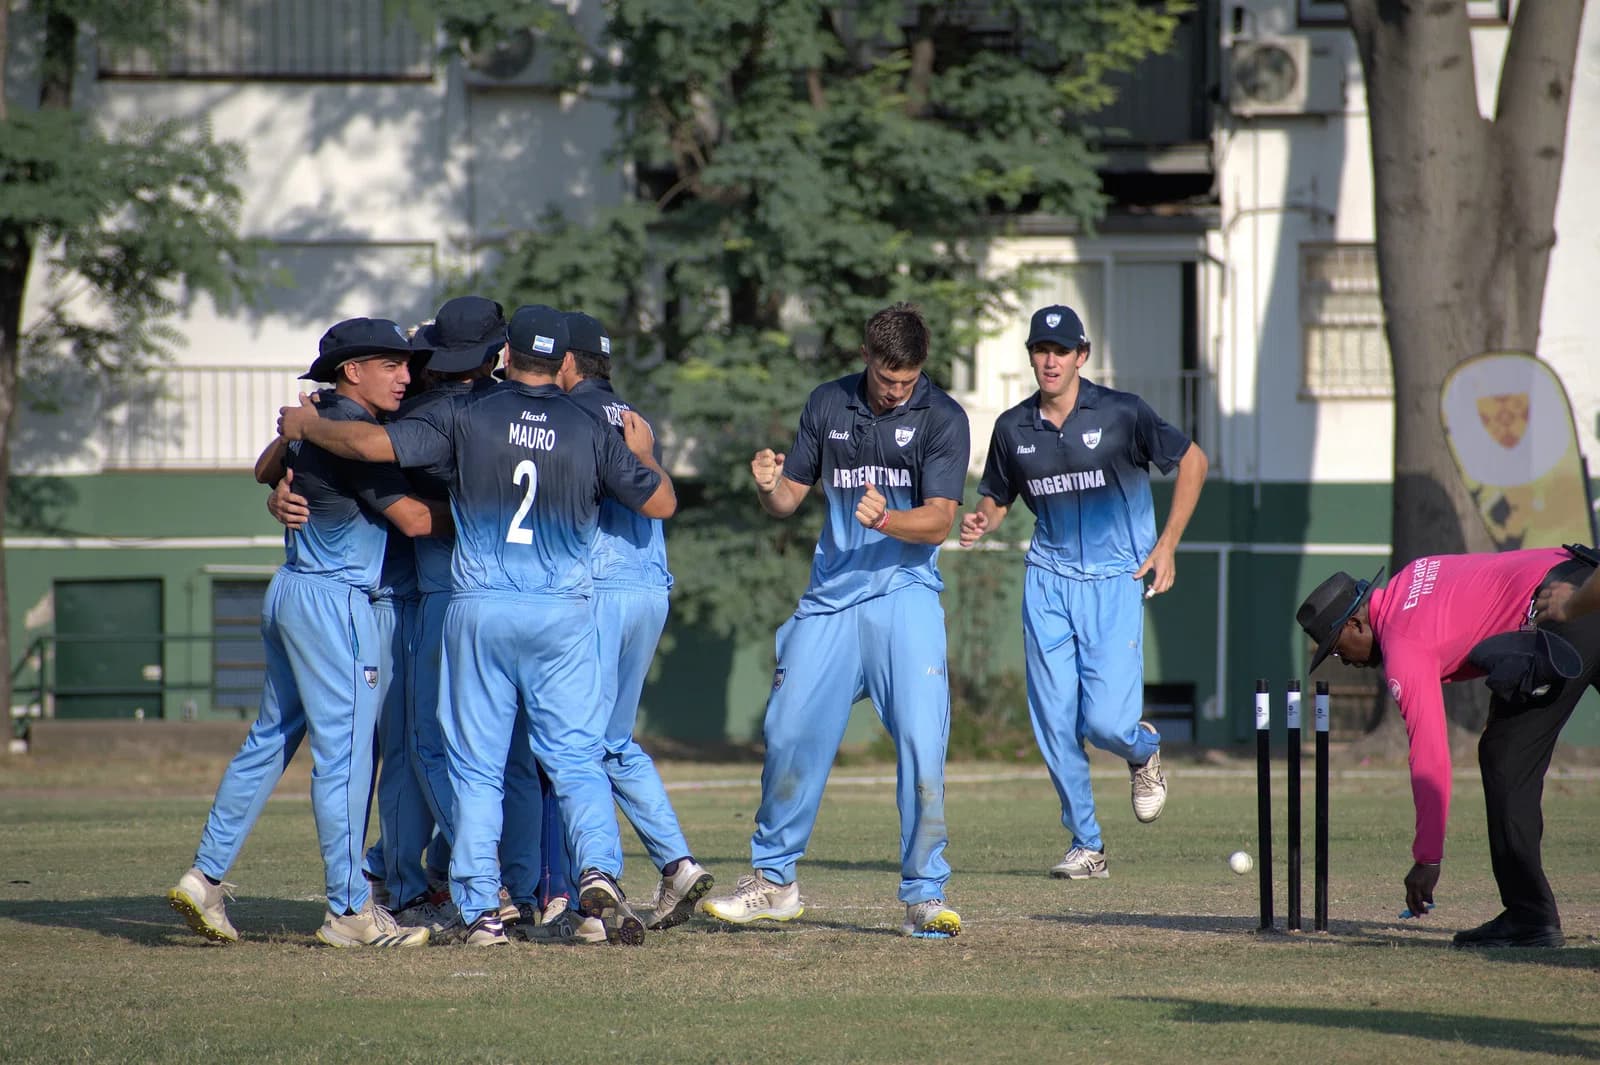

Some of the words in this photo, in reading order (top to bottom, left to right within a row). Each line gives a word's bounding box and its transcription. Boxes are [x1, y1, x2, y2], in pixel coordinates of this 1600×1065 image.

[508, 422, 556, 451] MAURO
[833, 465, 912, 489] ARGENTINA
[505, 459, 538, 545] 2
[1402, 558, 1428, 611] Emirates
